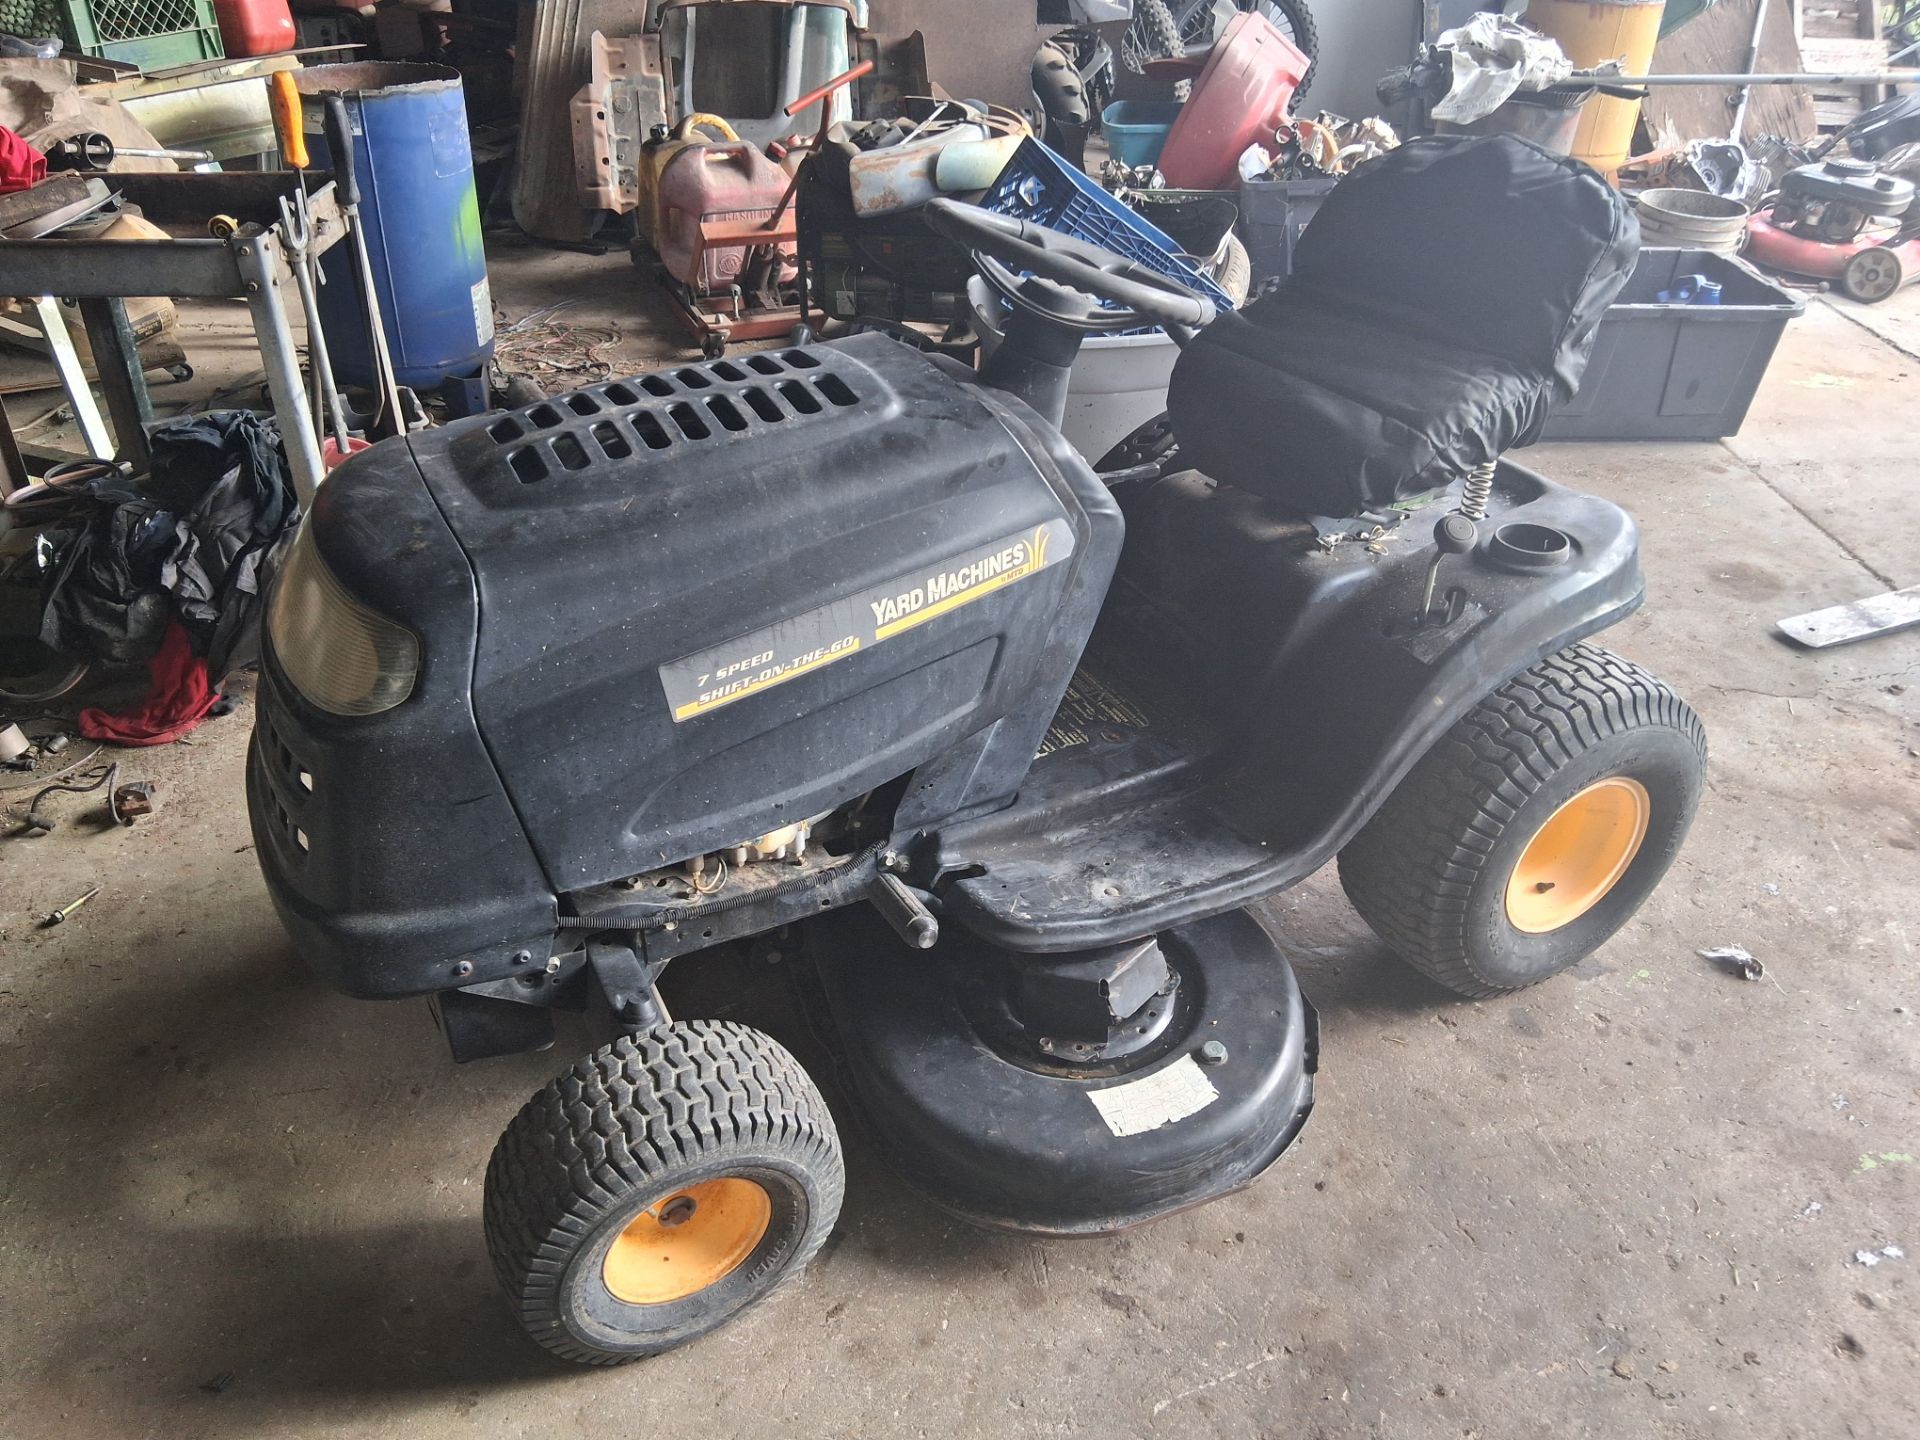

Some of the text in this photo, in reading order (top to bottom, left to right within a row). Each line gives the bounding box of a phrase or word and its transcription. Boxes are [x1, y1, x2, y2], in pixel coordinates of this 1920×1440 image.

[870, 543, 1025, 626] YARD MACHINES
[697, 650, 774, 688] 7 SPEED
[697, 636, 854, 706] SHIFT-ON-THE-GO
